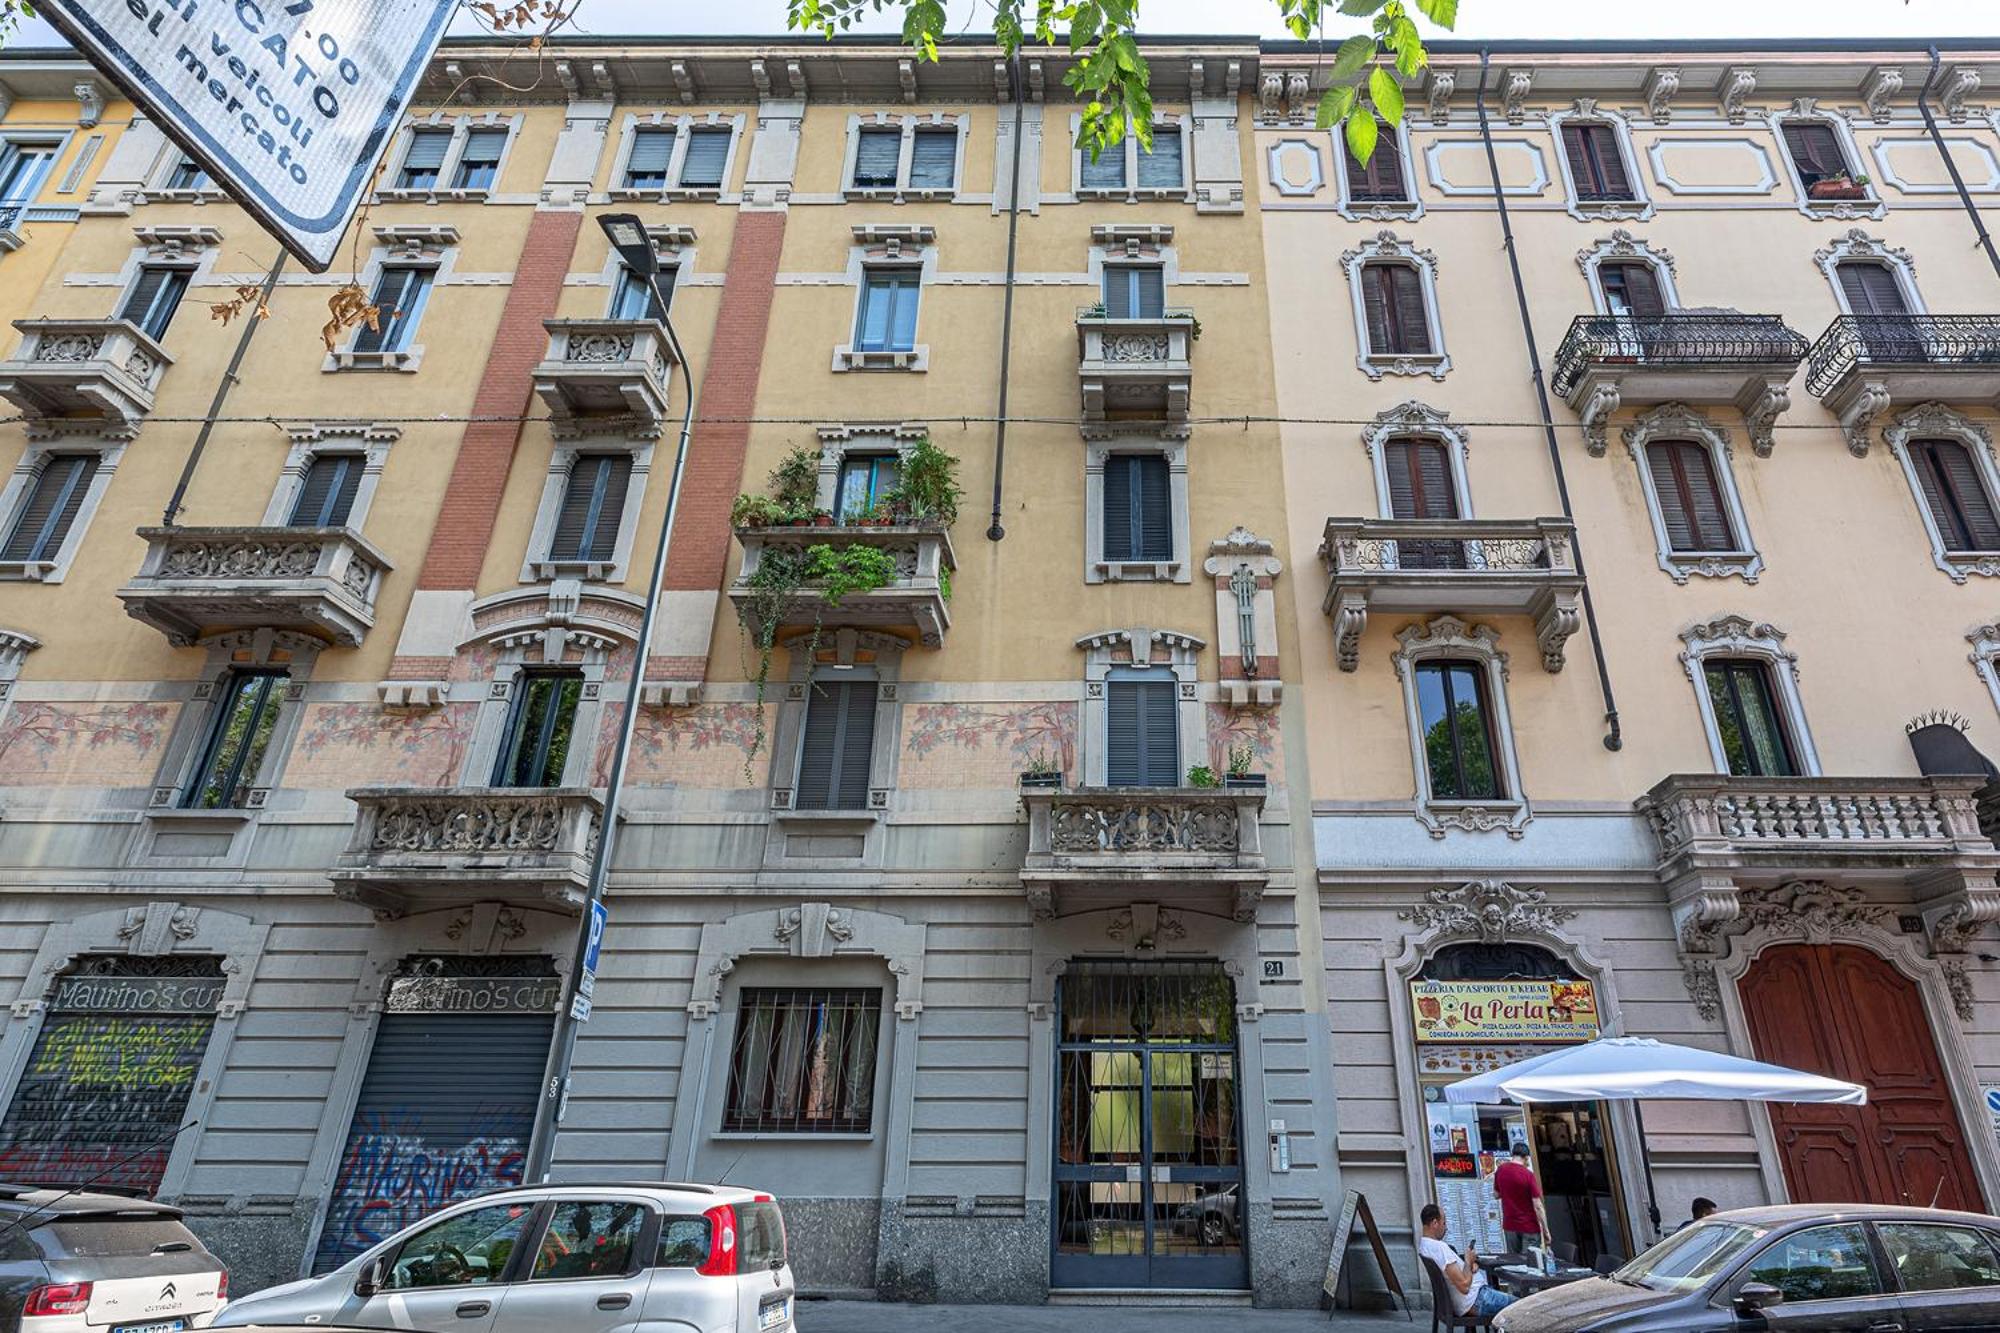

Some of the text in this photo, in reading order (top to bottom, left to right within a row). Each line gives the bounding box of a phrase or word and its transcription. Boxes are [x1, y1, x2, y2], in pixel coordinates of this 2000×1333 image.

[222, 0, 340, 119] CATO
[212, 31, 314, 149] veicoli
[175, 43, 307, 185] mercato
[587, 911, 603, 960] P
[1267, 962, 1281, 974] 21
[55, 981, 177, 1009] Maurino's
[1414, 984, 1455, 993] PIZZERIA
[1510, 984, 1517, 993] E
[1460, 999, 1544, 1026] La Perla
